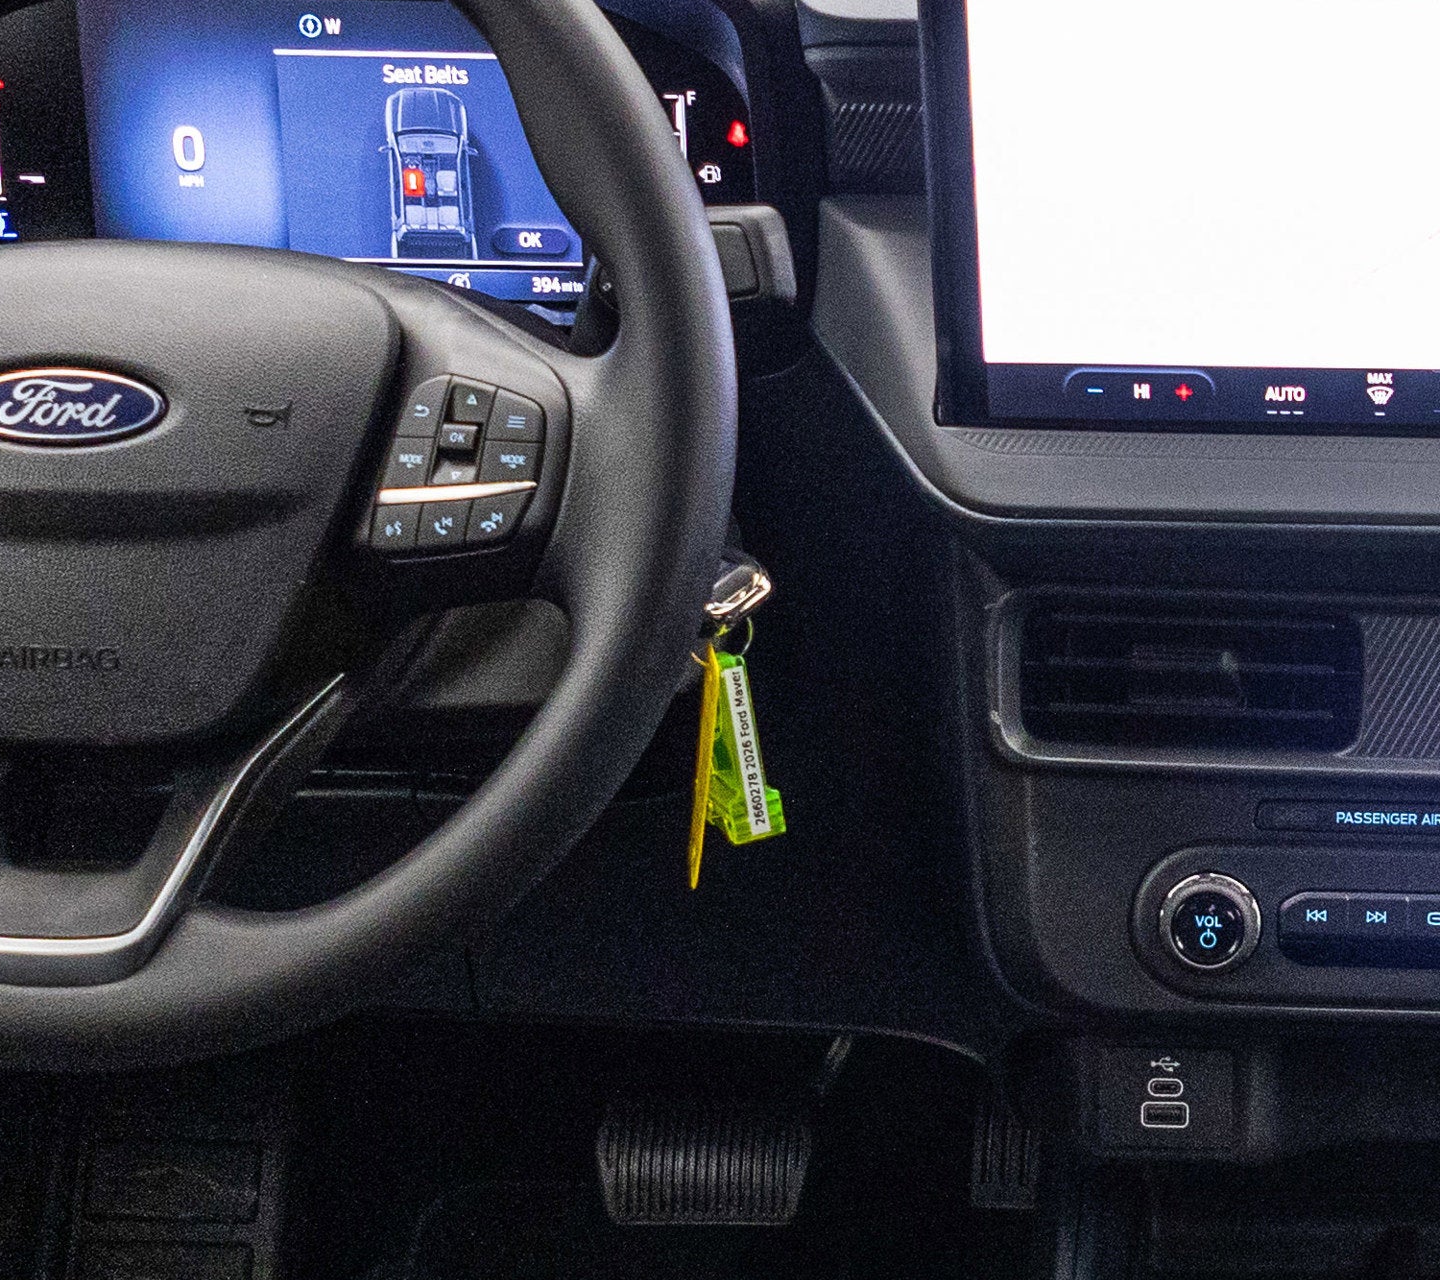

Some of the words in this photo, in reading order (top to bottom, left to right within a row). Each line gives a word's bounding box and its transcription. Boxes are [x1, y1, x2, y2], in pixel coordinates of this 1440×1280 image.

[324, 18, 341, 35] W
[382, 64, 423, 84] Seat
[424, 64, 469, 85] Belts
[686, 90, 696, 106] F
[172, 125, 206, 171] 0
[178, 174, 205, 188] MPH
[518, 231, 543, 248] OK
[532, 276, 561, 293] 394
[1367, 373, 1393, 384] MAX
[1133, 383, 1151, 399] HI
[1265, 386, 1306, 402] AUTO
[449, 432, 465, 443] OK
[500, 454, 527, 465] MODE
[0, 646, 120, 669] AIRBAG
[738, 710, 750, 738] Ford
[741, 740, 756, 770] 2026
[748, 772, 766, 826] 2660278
[1336, 811, 1417, 825] PASSENGER
[1195, 914, 1222, 928] VOL
